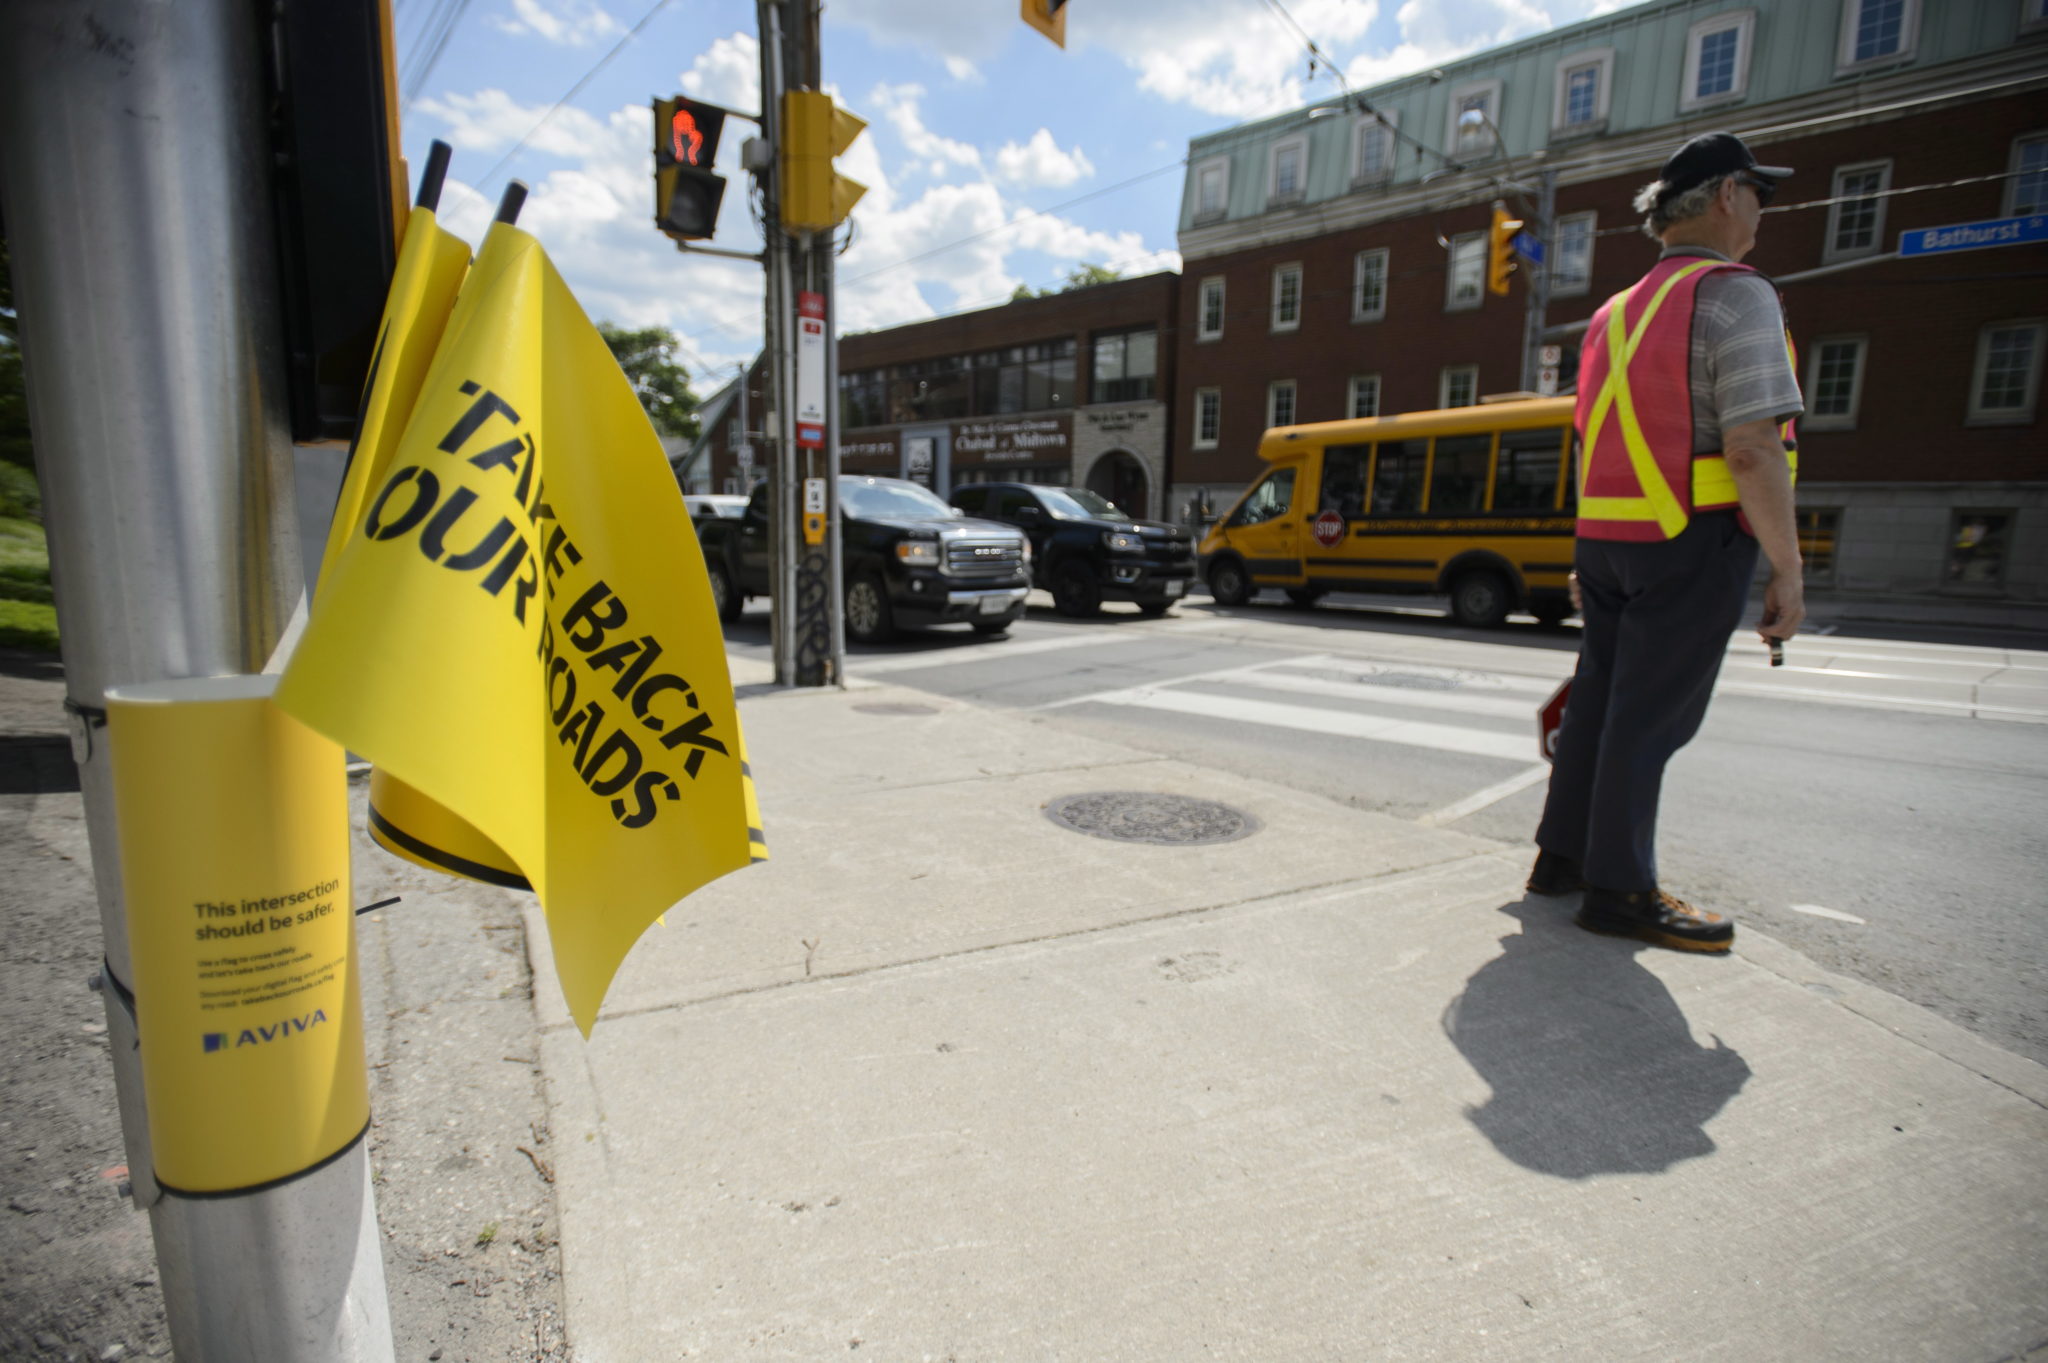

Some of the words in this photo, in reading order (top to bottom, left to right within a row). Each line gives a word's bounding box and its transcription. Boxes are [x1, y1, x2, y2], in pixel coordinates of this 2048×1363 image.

[1922, 221, 2021, 249] Bathurst
[364, 465, 539, 630] OUR
[1317, 521, 1342, 536] STOP
[437, 379, 583, 600] TAKE
[560, 580, 731, 781] BACK
[536, 606, 681, 829] ROADS
[194, 901, 237, 919] This
[241, 879, 339, 914] intersection
[195, 917, 264, 941] should
[269, 915, 292, 931] be
[296, 902, 335, 925] safer.
[236, 1008, 328, 1048] AVIVA
